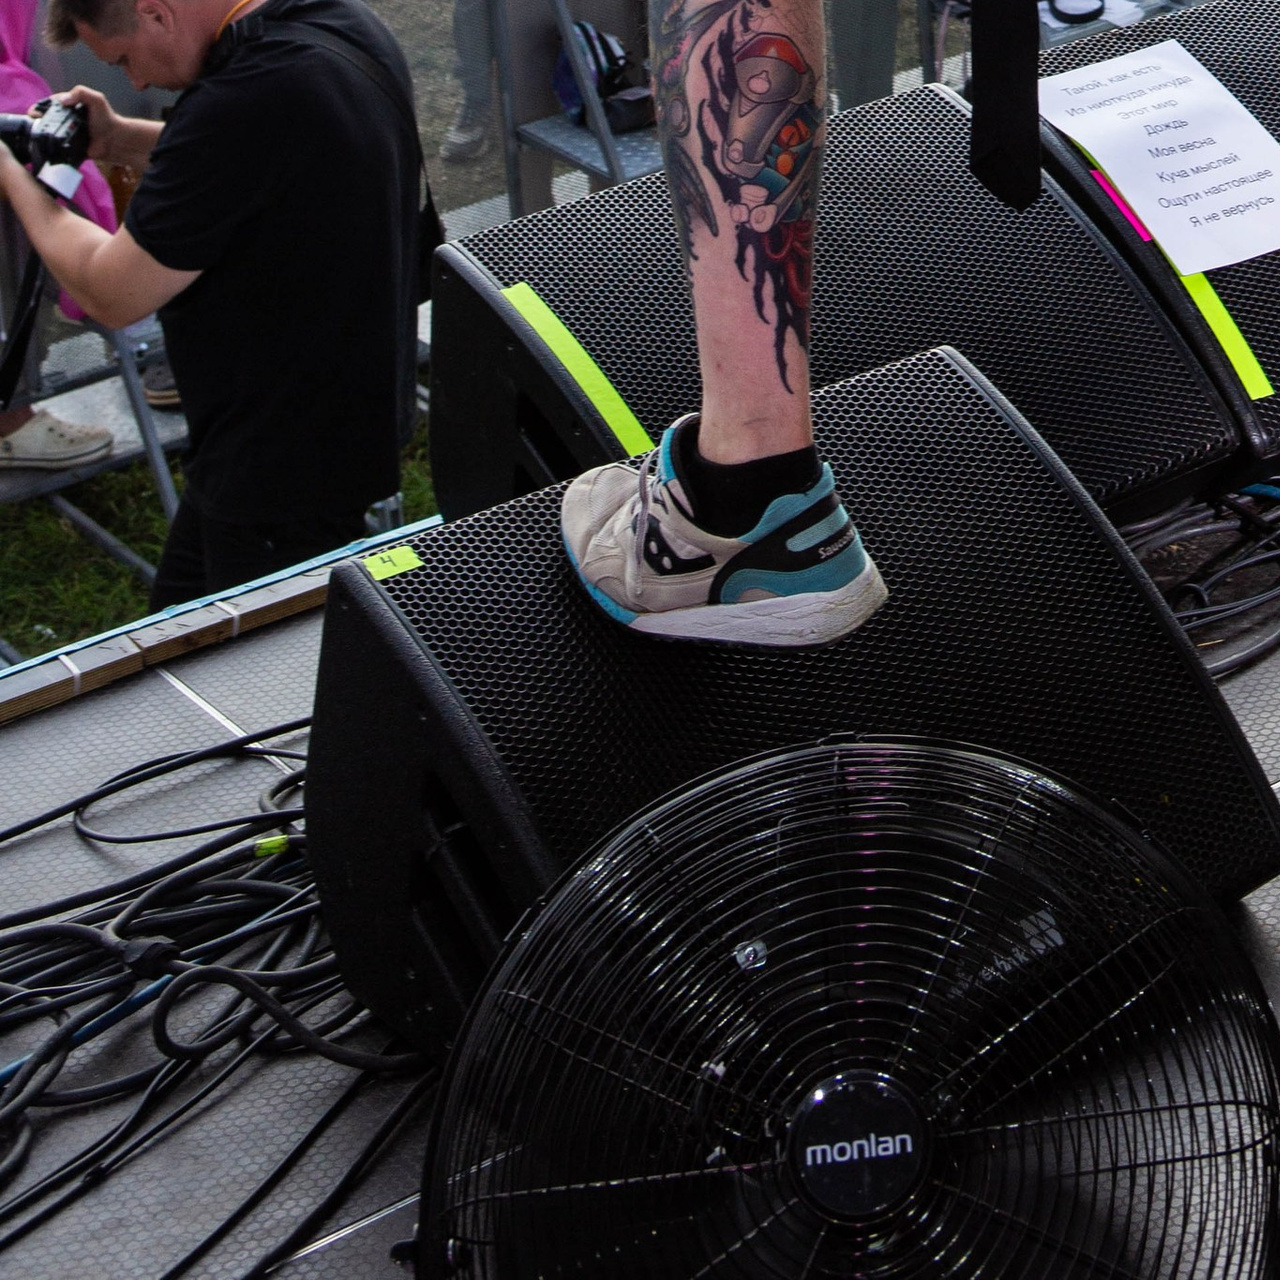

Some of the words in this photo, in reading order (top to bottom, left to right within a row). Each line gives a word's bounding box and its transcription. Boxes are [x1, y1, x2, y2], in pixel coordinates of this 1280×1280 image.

[1061, 79, 1108, 97] Такой,
[1108, 72, 1133, 85] как
[1133, 64, 1162, 77] есть
[1065, 106, 1087, 118] Из
[1088, 89, 1147, 111] ниоткуда
[1146, 75, 1193, 94] никуда
[1117, 107, 1150, 120] Этот
[1152, 98, 1179, 111] мир
[1143, 118, 1189, 137] Дождь
[1147, 145, 1178, 159] Моя
[1180, 136, 1217, 154] весна
[1156, 168, 1190, 184] Куча
[1190, 152, 1242, 176] мыслей
[1157, 191, 1204, 209] Ощути
[1202, 168, 1274, 197] настоящее
[1189, 215, 1202, 228] Я
[1203, 211, 1221, 224] не
[1221, 195, 1275, 217] вернусь
[380, 555, 397, 567] 4
[806, 1132, 913, 1166] monlan
